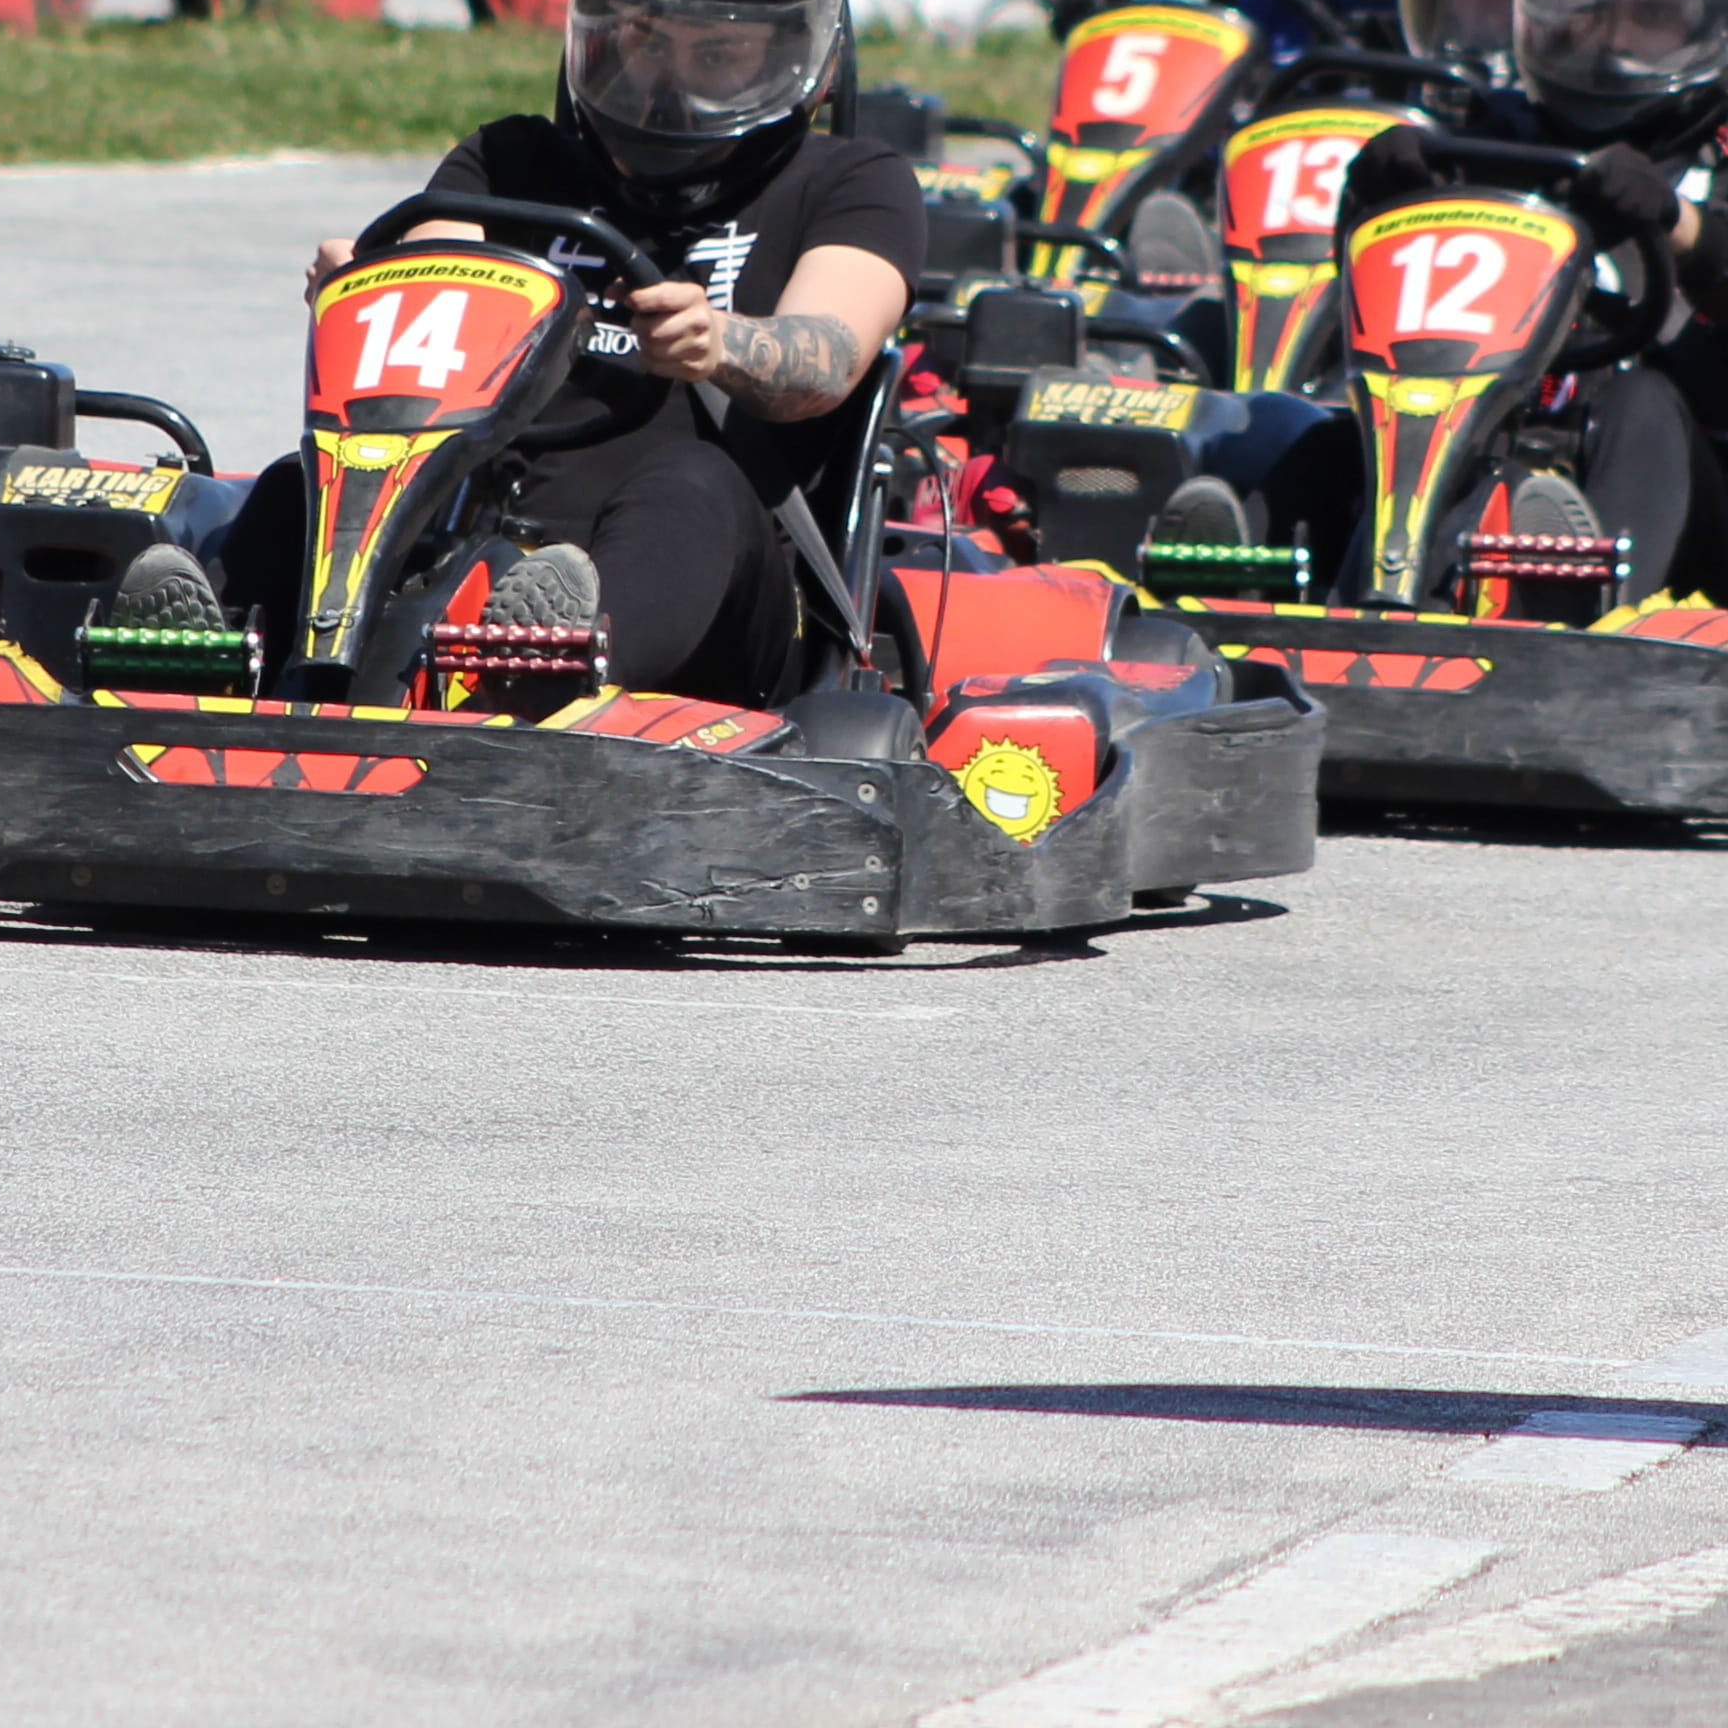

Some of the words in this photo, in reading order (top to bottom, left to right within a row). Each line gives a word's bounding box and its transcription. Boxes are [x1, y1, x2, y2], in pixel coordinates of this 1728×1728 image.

[1092, 34, 1169, 118] 5
[1262, 135, 1360, 230] 13
[338, 263, 529, 296] kartingdelsol.es
[1391, 232, 1507, 335] 12
[352, 288, 470, 391] 14
[12, 465, 172, 495] KARTING
